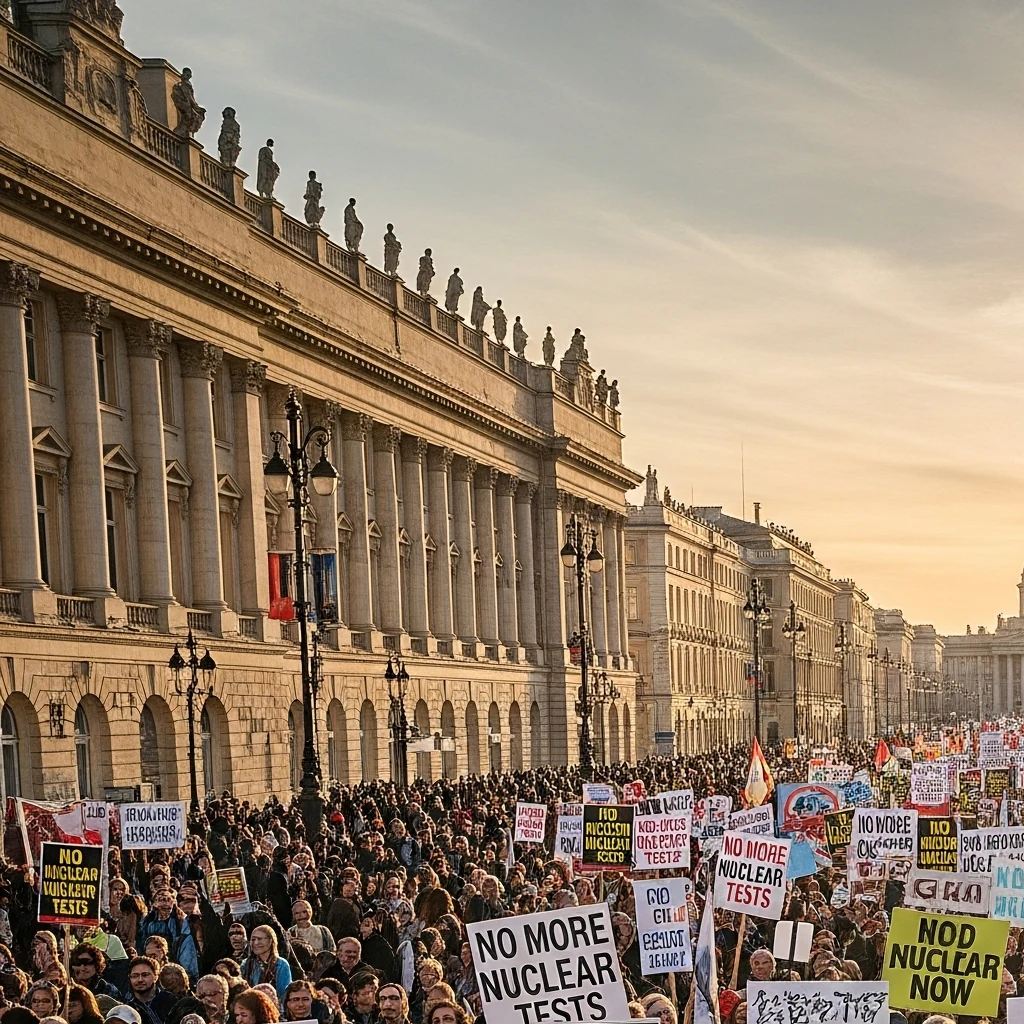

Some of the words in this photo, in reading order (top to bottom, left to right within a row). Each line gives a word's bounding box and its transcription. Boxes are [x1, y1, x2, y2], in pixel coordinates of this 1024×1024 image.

[724, 836, 743, 857] NO
[719, 859, 783, 887] NUCLEAR
[727, 882, 772, 908] TESTS
[475, 927, 517, 963] NO
[523, 912, 609, 955] MORE
[918, 918, 976, 949] NOD
[479, 952, 617, 1002] NUCLEAR
[889, 943, 1000, 980] NUCLEAR
[910, 974, 975, 1006] NOW
